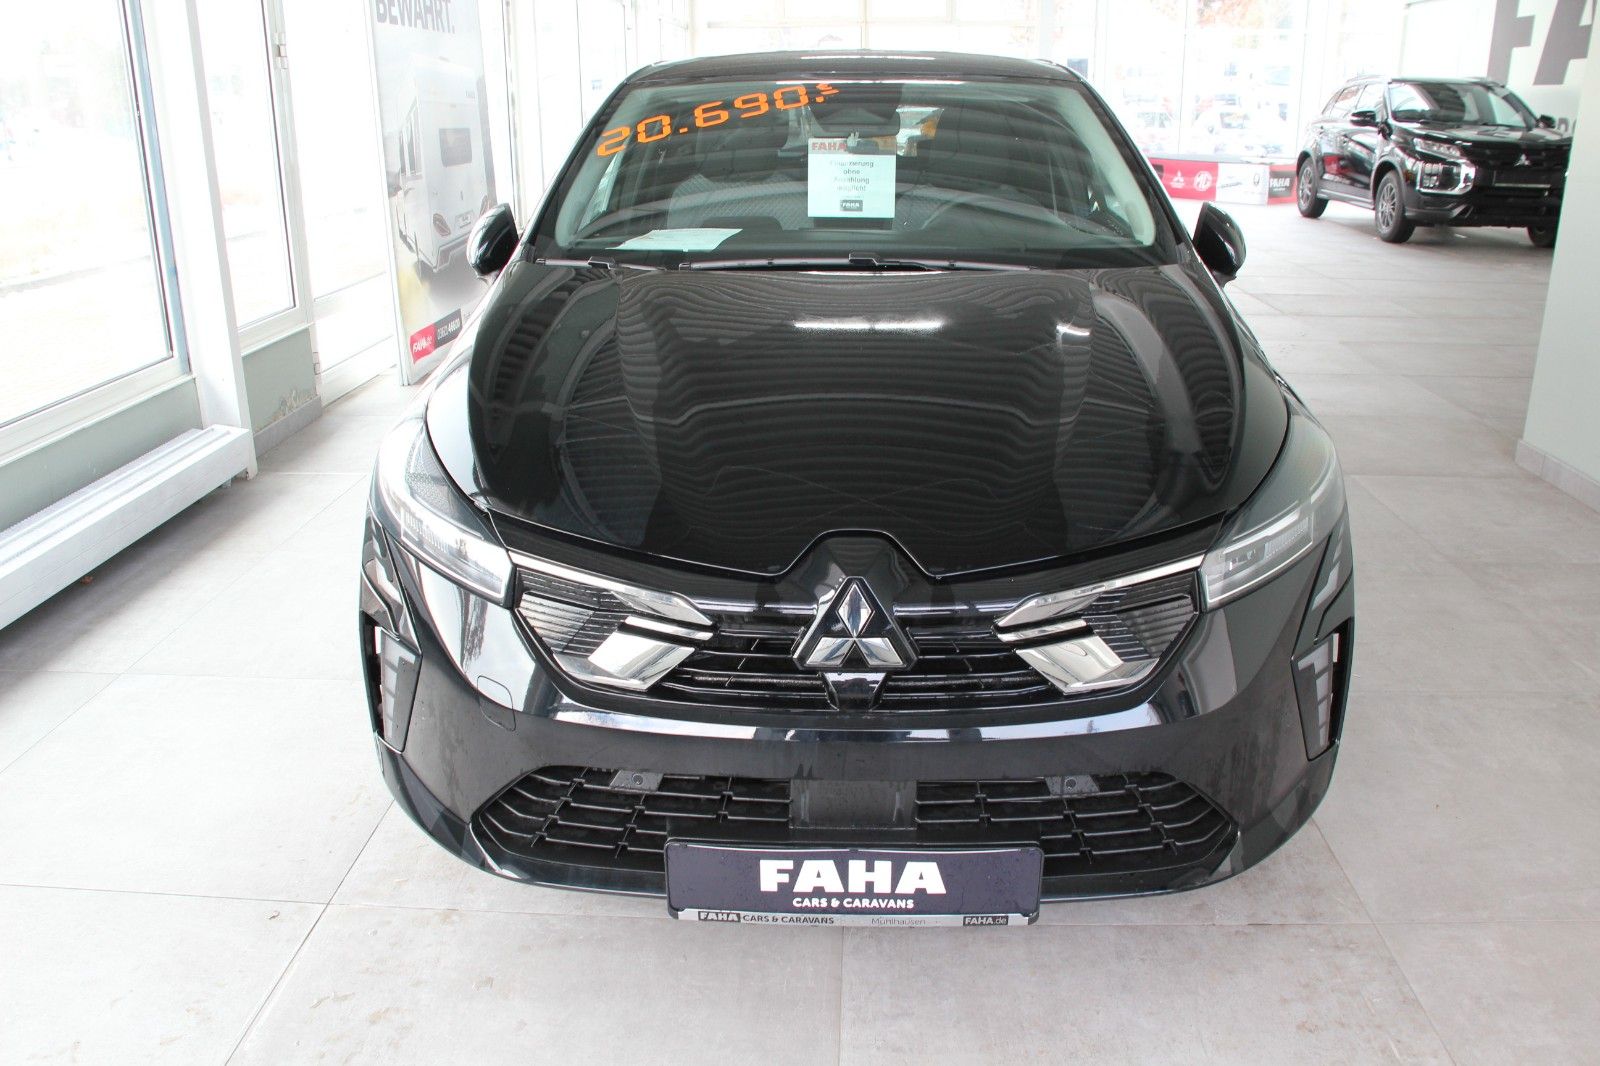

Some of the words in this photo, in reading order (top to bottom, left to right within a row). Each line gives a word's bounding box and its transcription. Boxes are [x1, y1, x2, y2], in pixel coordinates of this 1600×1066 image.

[811, 142, 847, 151] FAHA
[1194, 172, 1211, 190] MG
[759, 859, 947, 895] FAHA
[793, 897, 828, 908] CARS
[830, 898, 841, 908] &
[843, 898, 914, 909] CARAVANS
[700, 912, 739, 921] FAHA
[742, 914, 770, 923] CARS
[772, 915, 779, 923] &
[781, 916, 835, 925] CARAVANS
[965, 917, 1008, 925] FAHA.de
